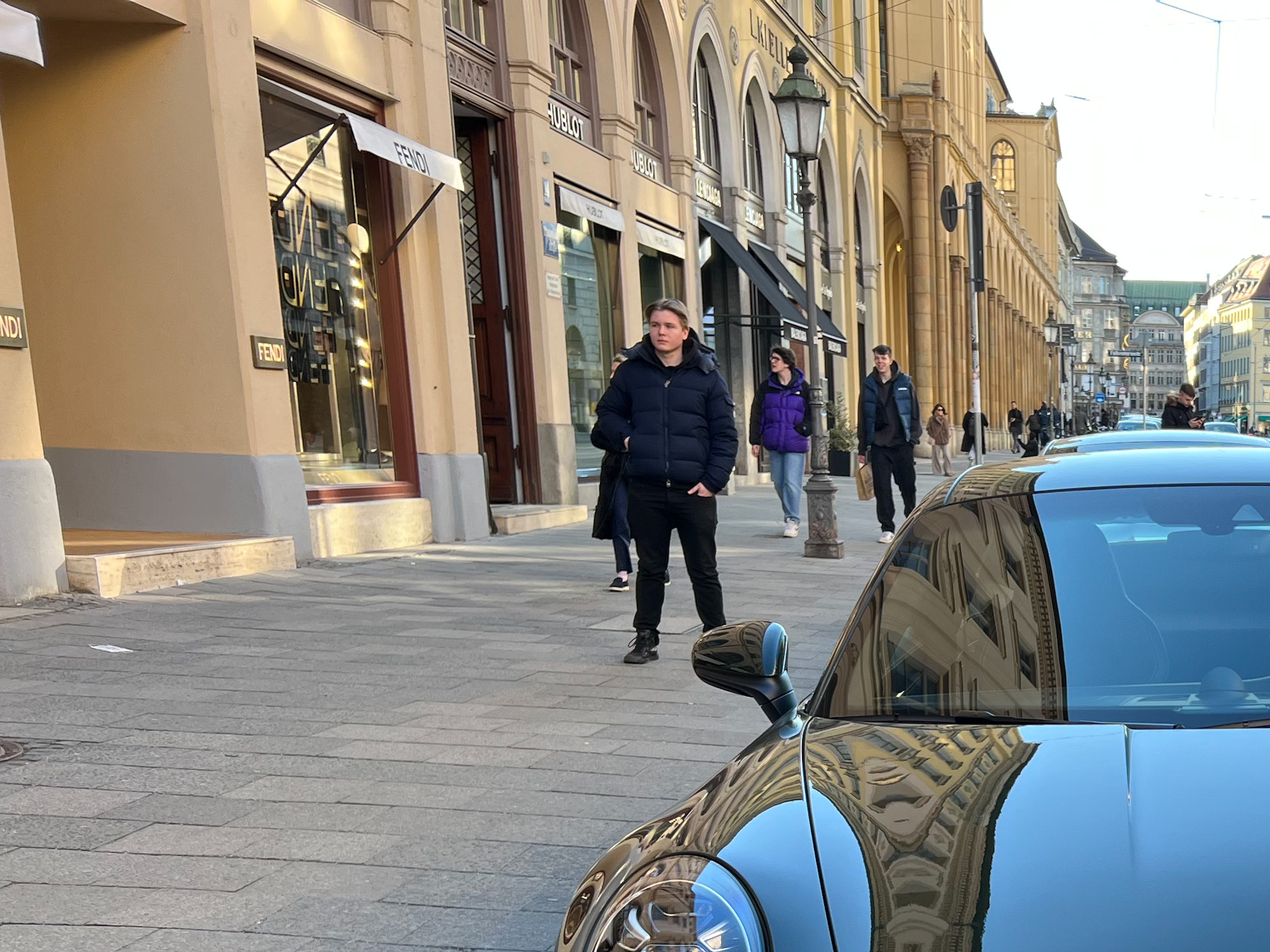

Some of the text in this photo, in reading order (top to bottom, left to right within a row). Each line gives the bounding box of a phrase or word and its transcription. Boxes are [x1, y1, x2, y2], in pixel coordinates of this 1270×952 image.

[548, 103, 584, 140] HUBLOT
[393, 141, 430, 176] FENDI
[257, 342, 285, 362] FENDI
